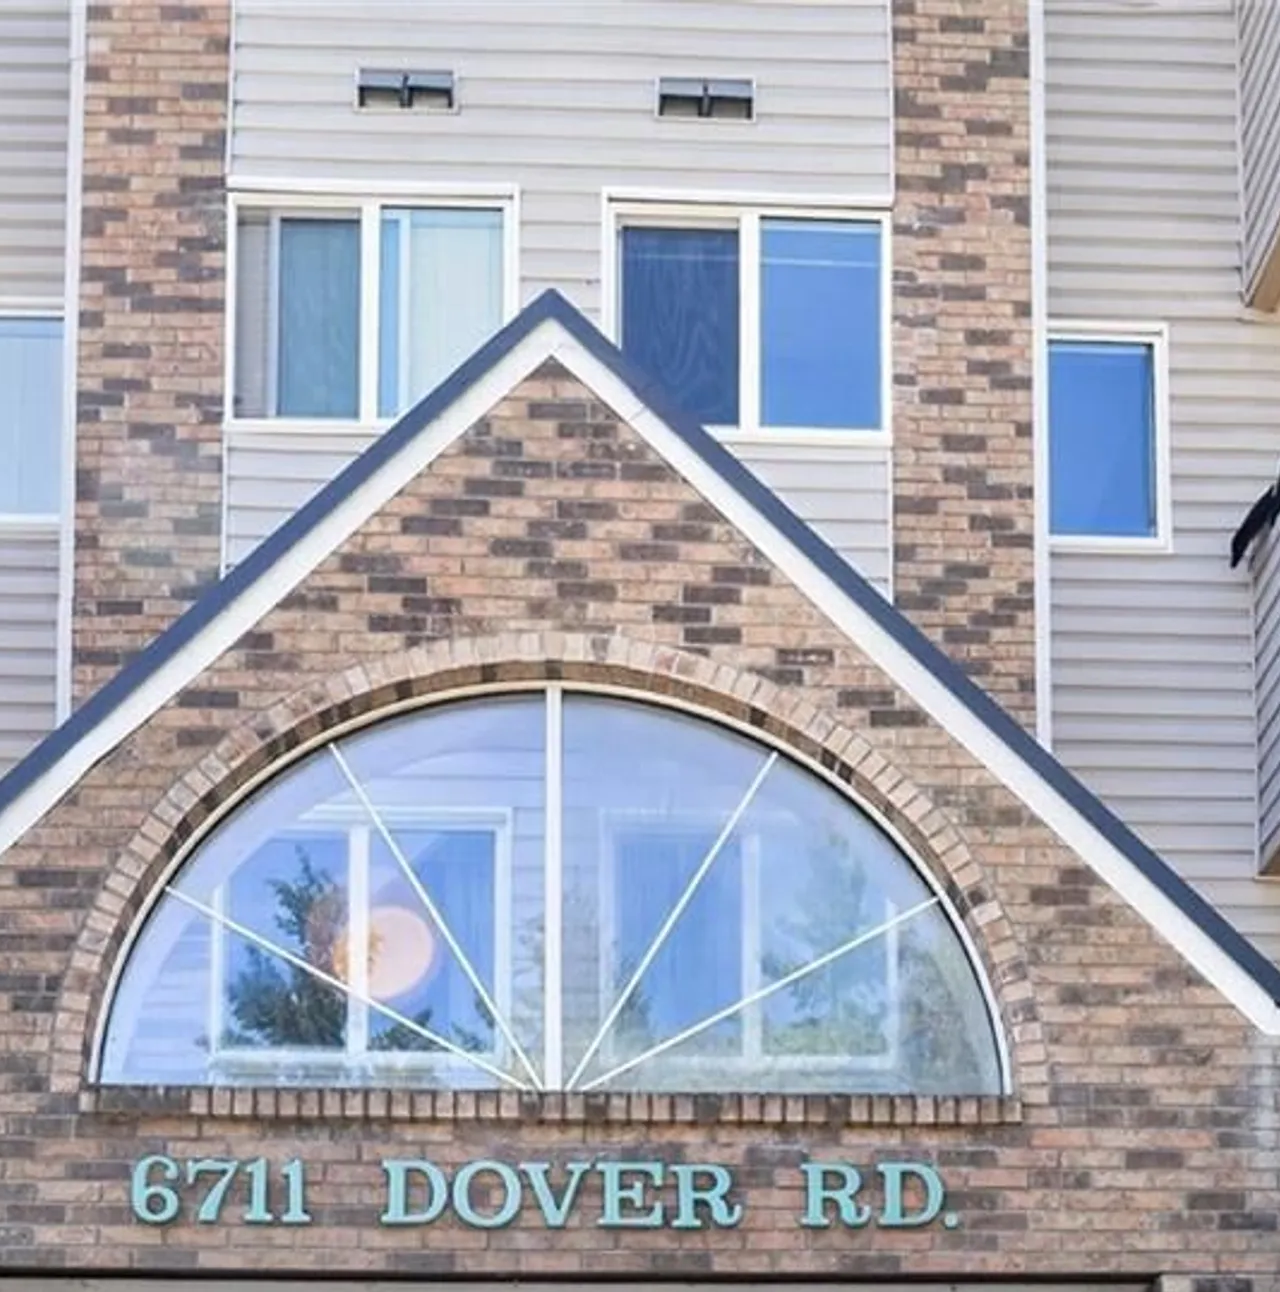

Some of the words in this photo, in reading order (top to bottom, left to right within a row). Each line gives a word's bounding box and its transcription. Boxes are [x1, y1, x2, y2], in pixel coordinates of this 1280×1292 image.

[131, 1154, 312, 1224] 6711
[380, 1158, 743, 1228] DOVER
[799, 1161, 960, 1229] RD.
